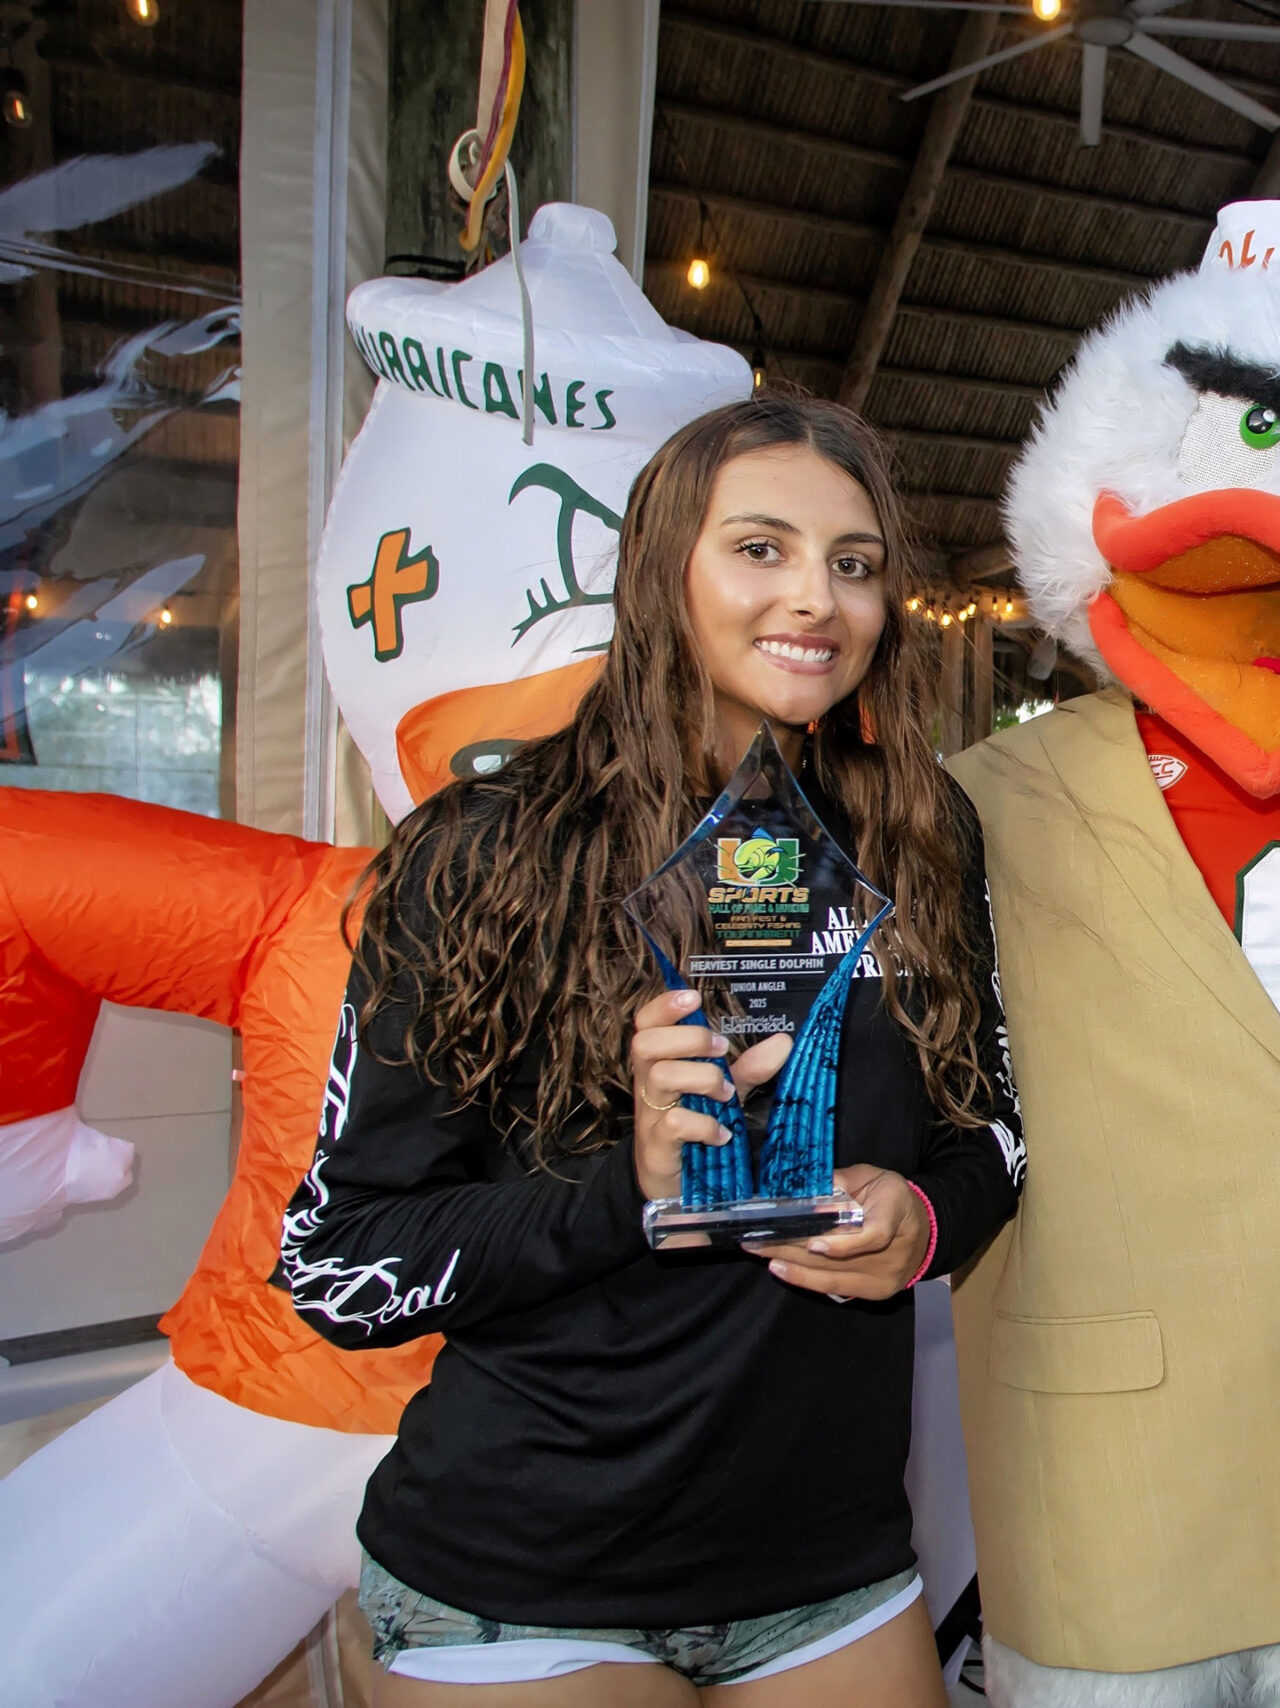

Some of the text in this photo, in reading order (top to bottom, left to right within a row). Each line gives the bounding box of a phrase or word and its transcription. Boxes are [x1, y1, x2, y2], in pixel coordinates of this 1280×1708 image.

[708, 887, 810, 904] SPORTS
[690, 958, 824, 972] HEAVIEST SINGLE DOLPHIN
[730, 981, 787, 994] JUNIOR ANGLER
[749, 998, 767, 1009] 2025
[720, 1014, 795, 1034] Islamorada
